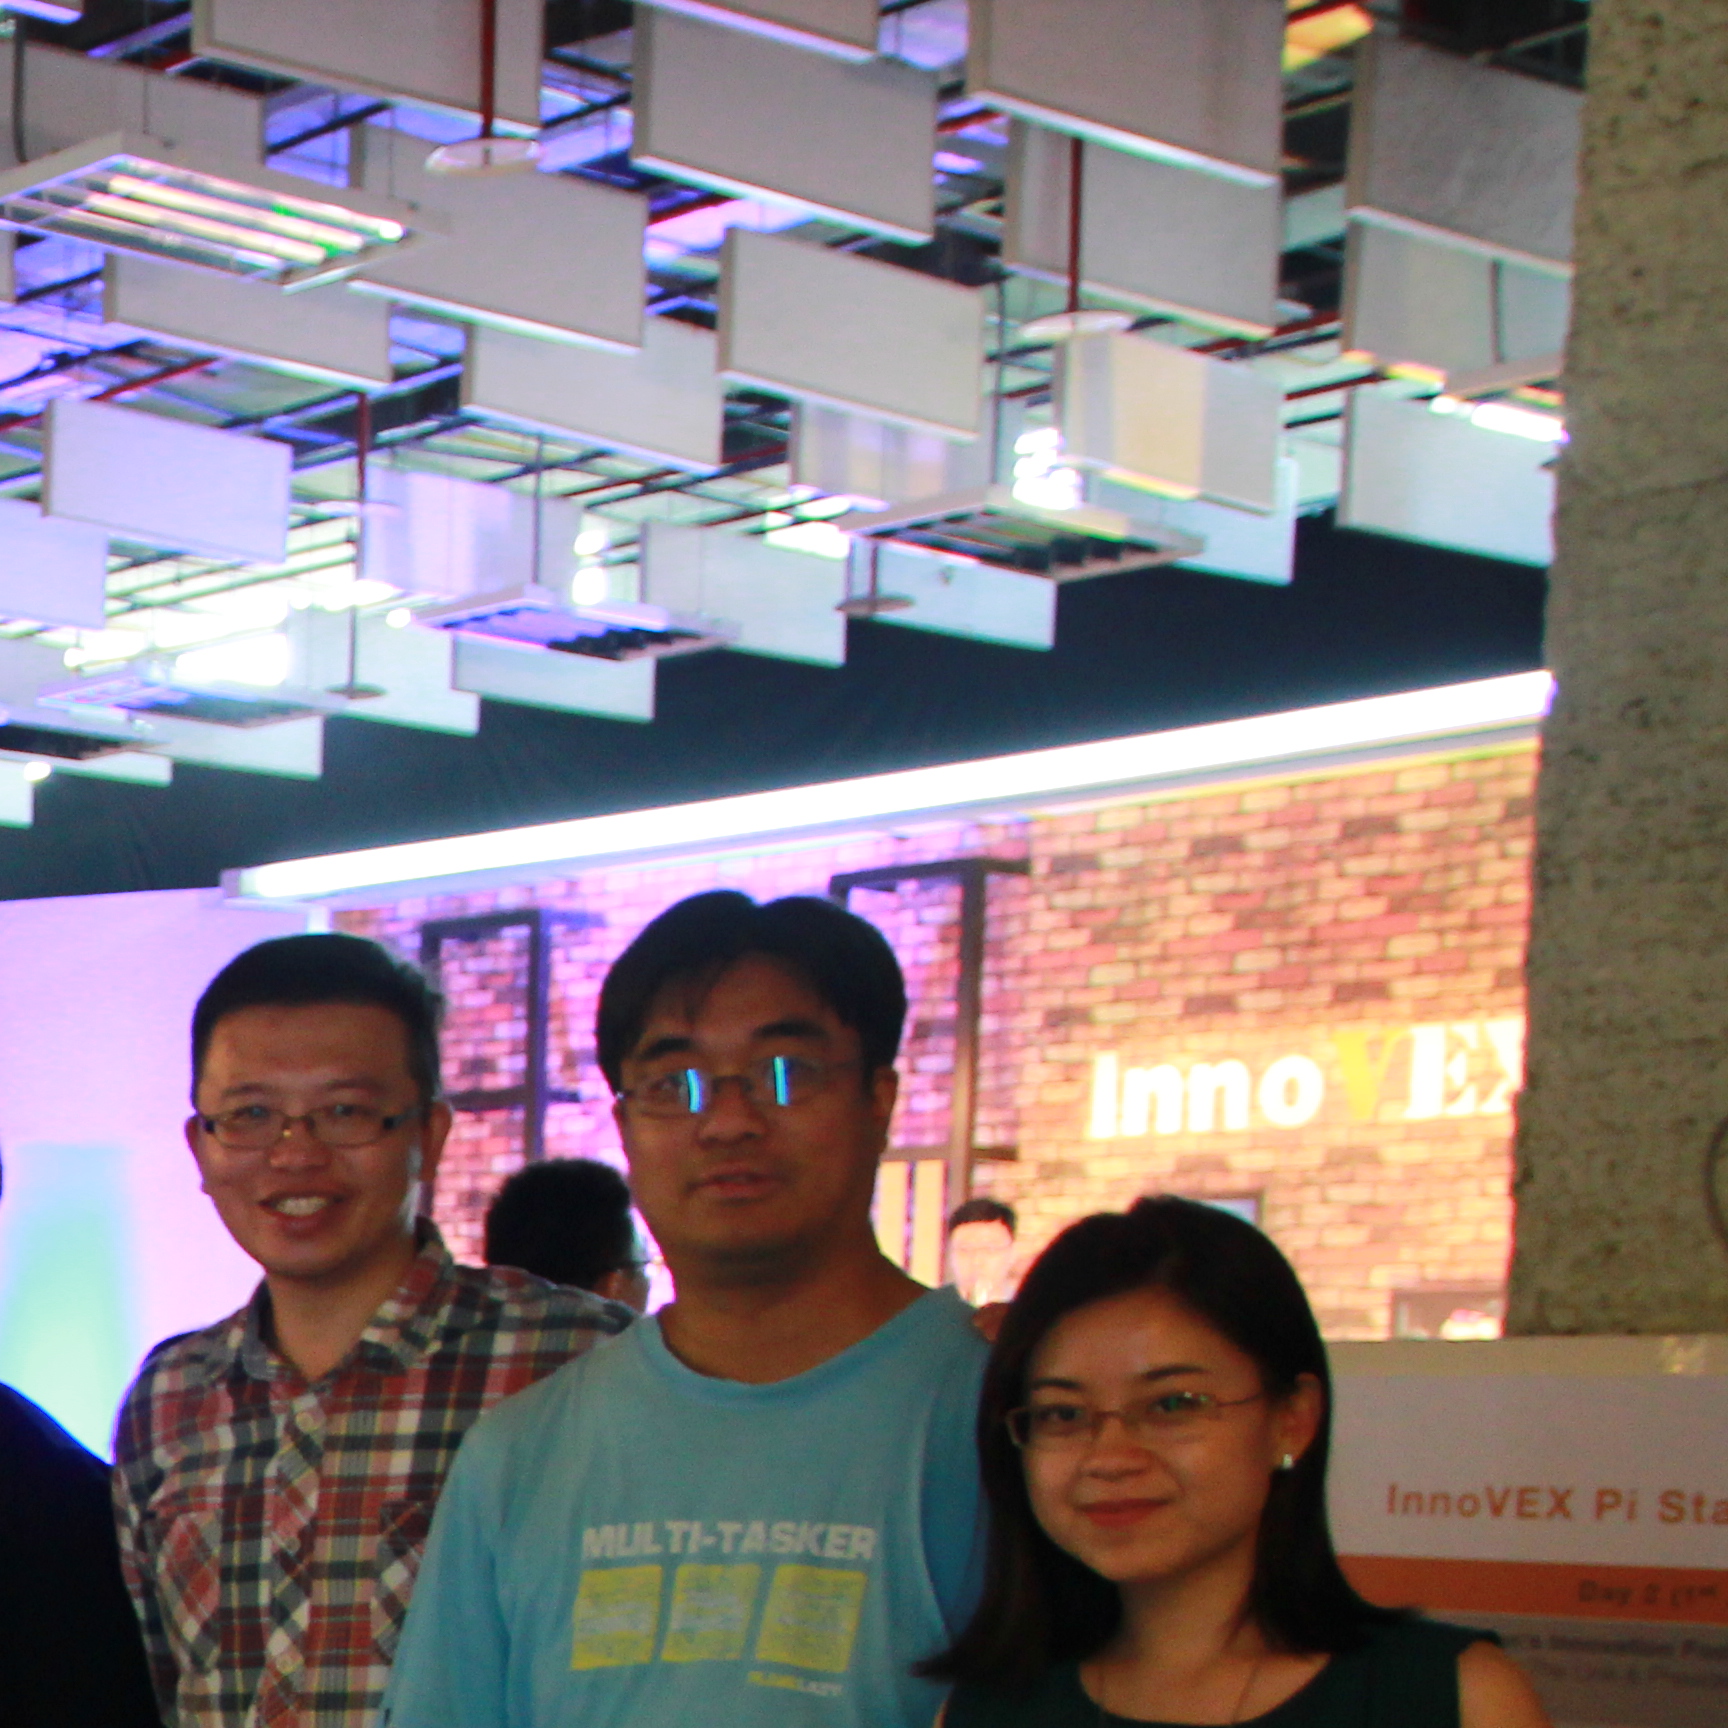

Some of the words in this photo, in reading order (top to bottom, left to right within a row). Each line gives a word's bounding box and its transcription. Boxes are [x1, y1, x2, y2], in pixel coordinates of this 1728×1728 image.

[1387, 1483, 1573, 1521] InnoVEX
[1596, 1488, 1638, 1523] Pi
[582, 1520, 876, 1560] MULTI-TASKER
